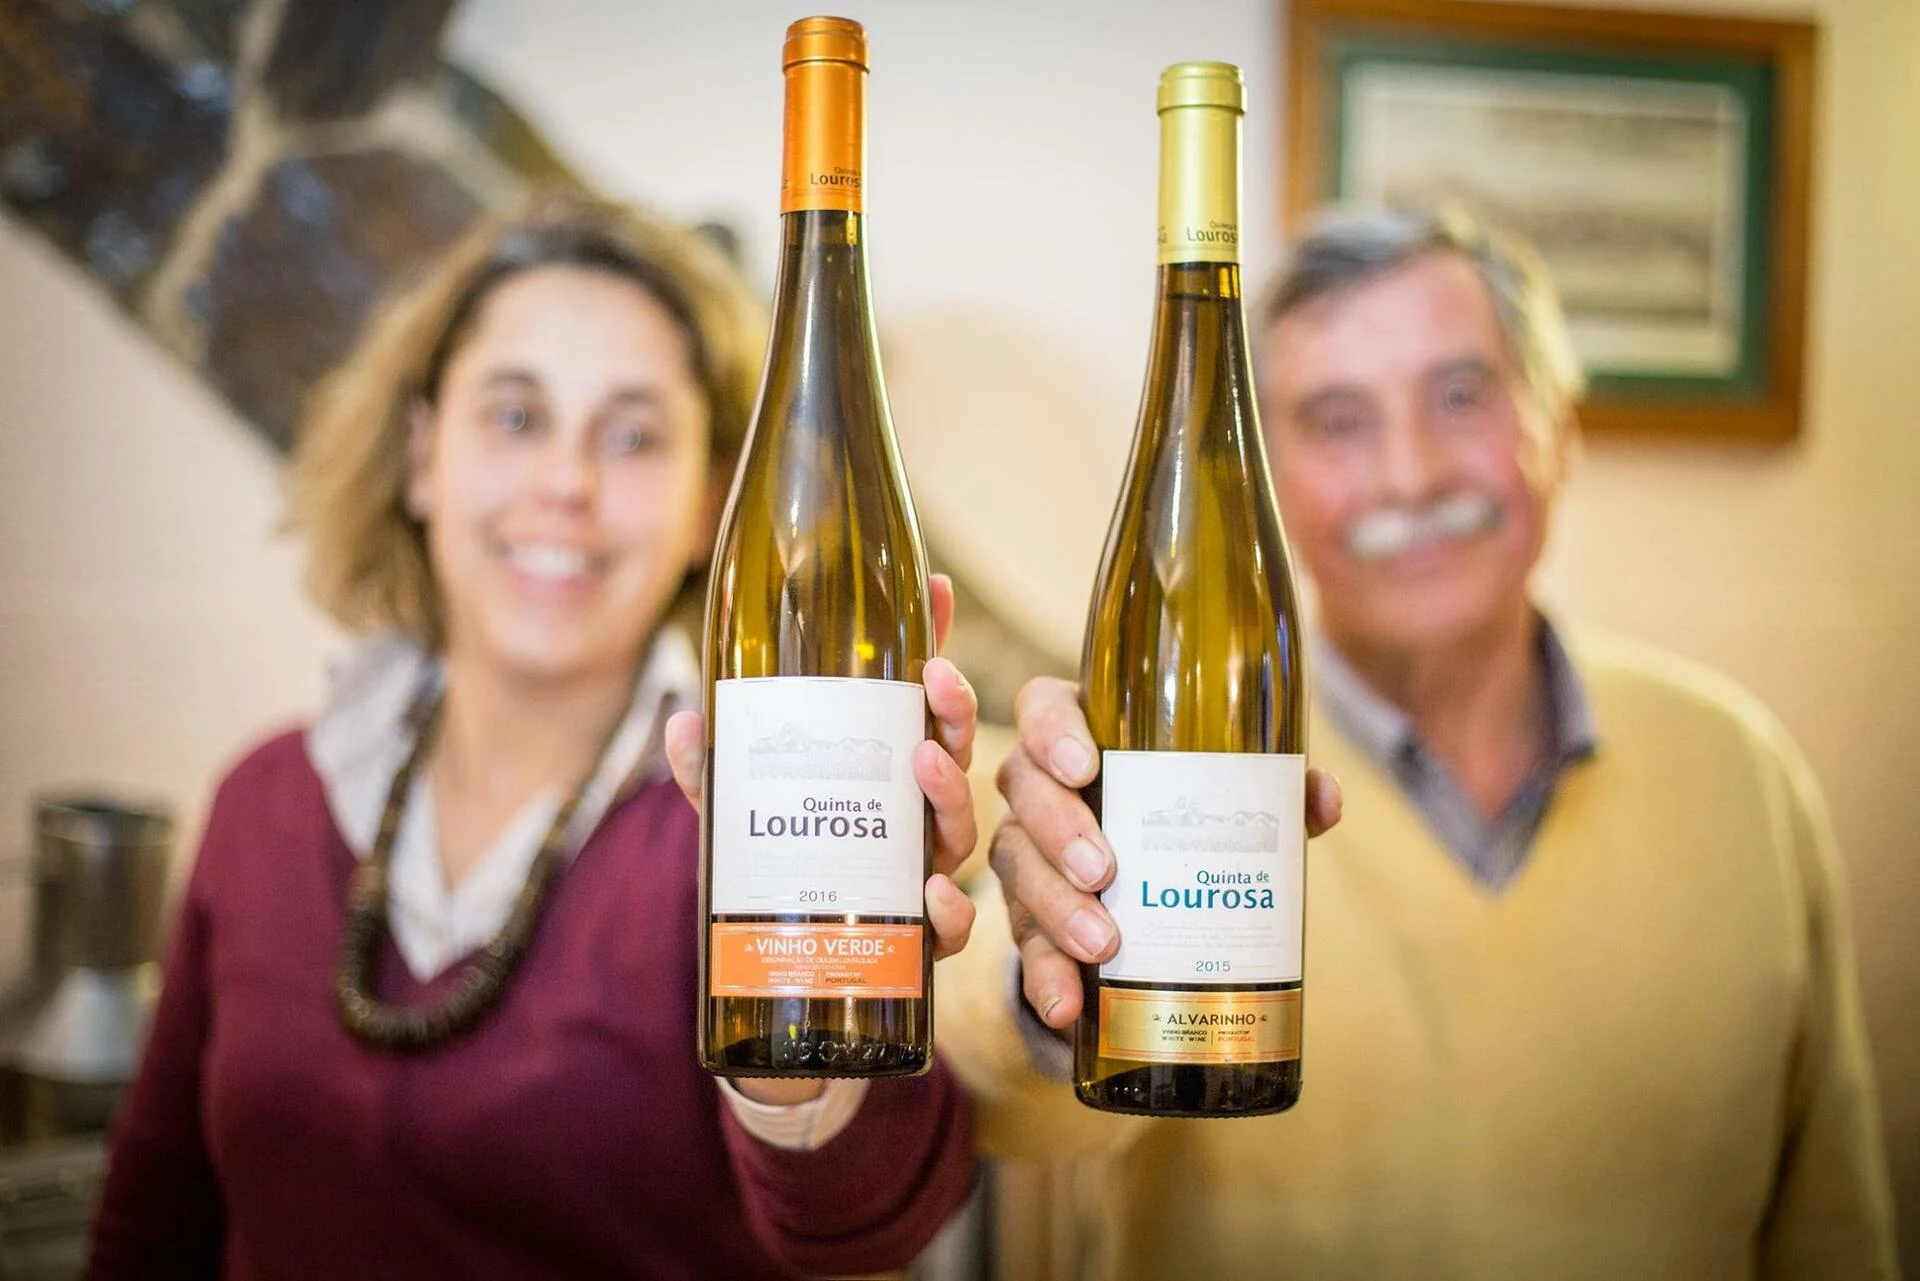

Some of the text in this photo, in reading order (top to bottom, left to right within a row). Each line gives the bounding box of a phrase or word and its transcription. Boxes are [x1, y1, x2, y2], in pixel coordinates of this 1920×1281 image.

[811, 172, 860, 188] Louros
[1186, 227, 1237, 244] Louros
[803, 797, 882, 812] Quinta de
[749, 810, 888, 839] Lourosa
[1196, 870, 1270, 885] Quinta de
[799, 890, 838, 903] 2016
[1142, 881, 1274, 909] Lourosa
[756, 938, 885, 956] VINHO VERDE
[1195, 960, 1231, 973] 2015
[825, 977, 868, 985] PORTUGAL
[1167, 1013, 1256, 1026] ALVARINHO
